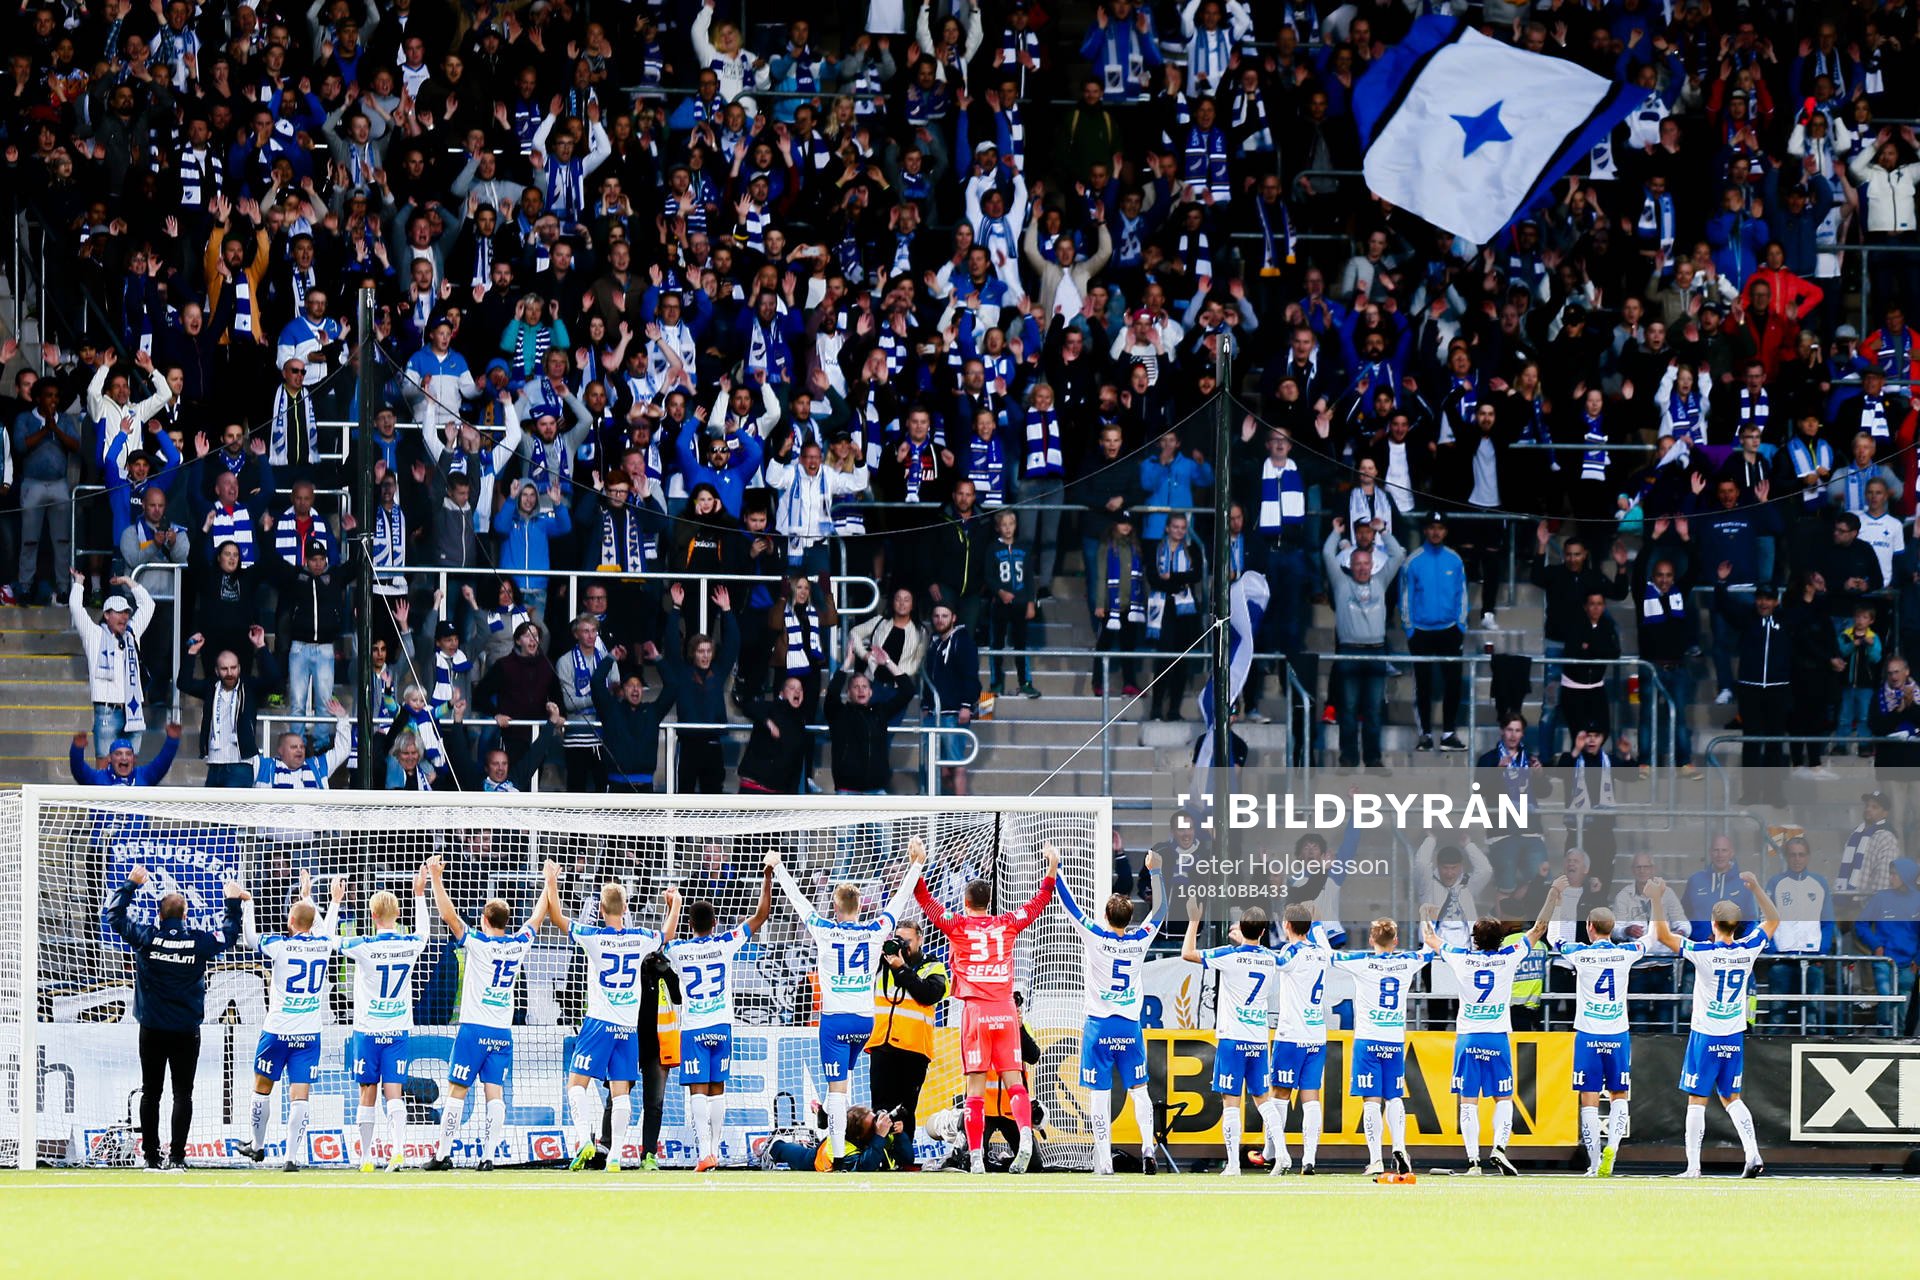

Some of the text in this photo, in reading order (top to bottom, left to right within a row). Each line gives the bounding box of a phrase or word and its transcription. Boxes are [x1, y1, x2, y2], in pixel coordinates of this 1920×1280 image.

[964, 925, 1007, 962] 31
[832, 942, 870, 976] 14
[1580, 955, 1597, 964] axs
[286, 959, 327, 994] 20
[491, 959, 519, 988] 15
[599, 953, 640, 989] 25
[966, 964, 1009, 977] SEFAB
[1111, 959, 1132, 992] 5
[375, 963, 411, 999] 17
[682, 962, 726, 1000] 23
[831, 974, 872, 986] SEFAB
[1245, 971, 1266, 1006] 7
[1310, 969, 1324, 1005] 6
[1474, 969, 1495, 1004] 9
[1594, 968, 1616, 1001] 4
[1714, 969, 1745, 1004] 19
[1379, 976, 1400, 1010] 8
[1464, 1003, 1505, 1014] SEFAB
[375, 1036, 393, 1045] RÖR
[1098, 1036, 1136, 1045] MÅNSSON
[1586, 1040, 1622, 1049] MÅNSSON
[257, 1057, 274, 1074] nt
[574, 1053, 593, 1071] nt
[684, 1057, 700, 1075] nt
[824, 1061, 841, 1077] nt
[452, 1063, 471, 1081] nt
[1082, 1067, 1098, 1085] nt
[1277, 1068, 1295, 1084] nt
[1357, 1072, 1374, 1089] nt
[1684, 1071, 1699, 1089] nt
[1219, 1073, 1235, 1090] nt
[1498, 1075, 1513, 1093] nt
